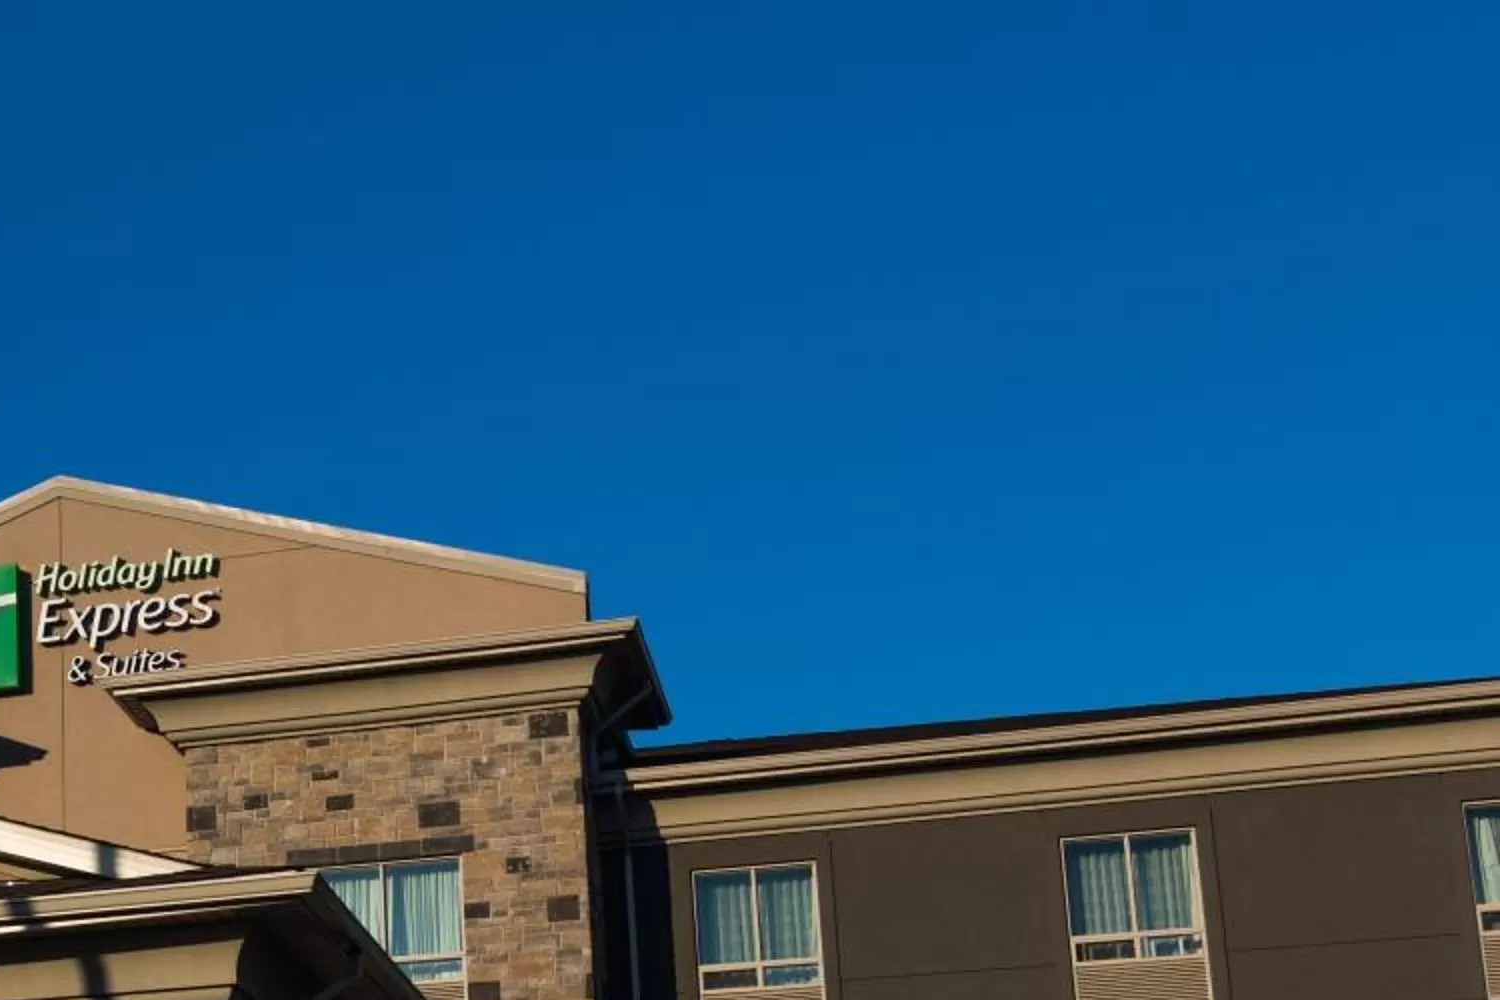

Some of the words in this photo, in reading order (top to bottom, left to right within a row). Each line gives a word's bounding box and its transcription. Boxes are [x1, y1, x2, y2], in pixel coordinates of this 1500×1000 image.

[35, 554, 156, 595] Holiday
[163, 548, 214, 580] Inn
[36, 589, 216, 649] Express
[67, 656, 88, 682] &
[94, 648, 182, 680] Suites
